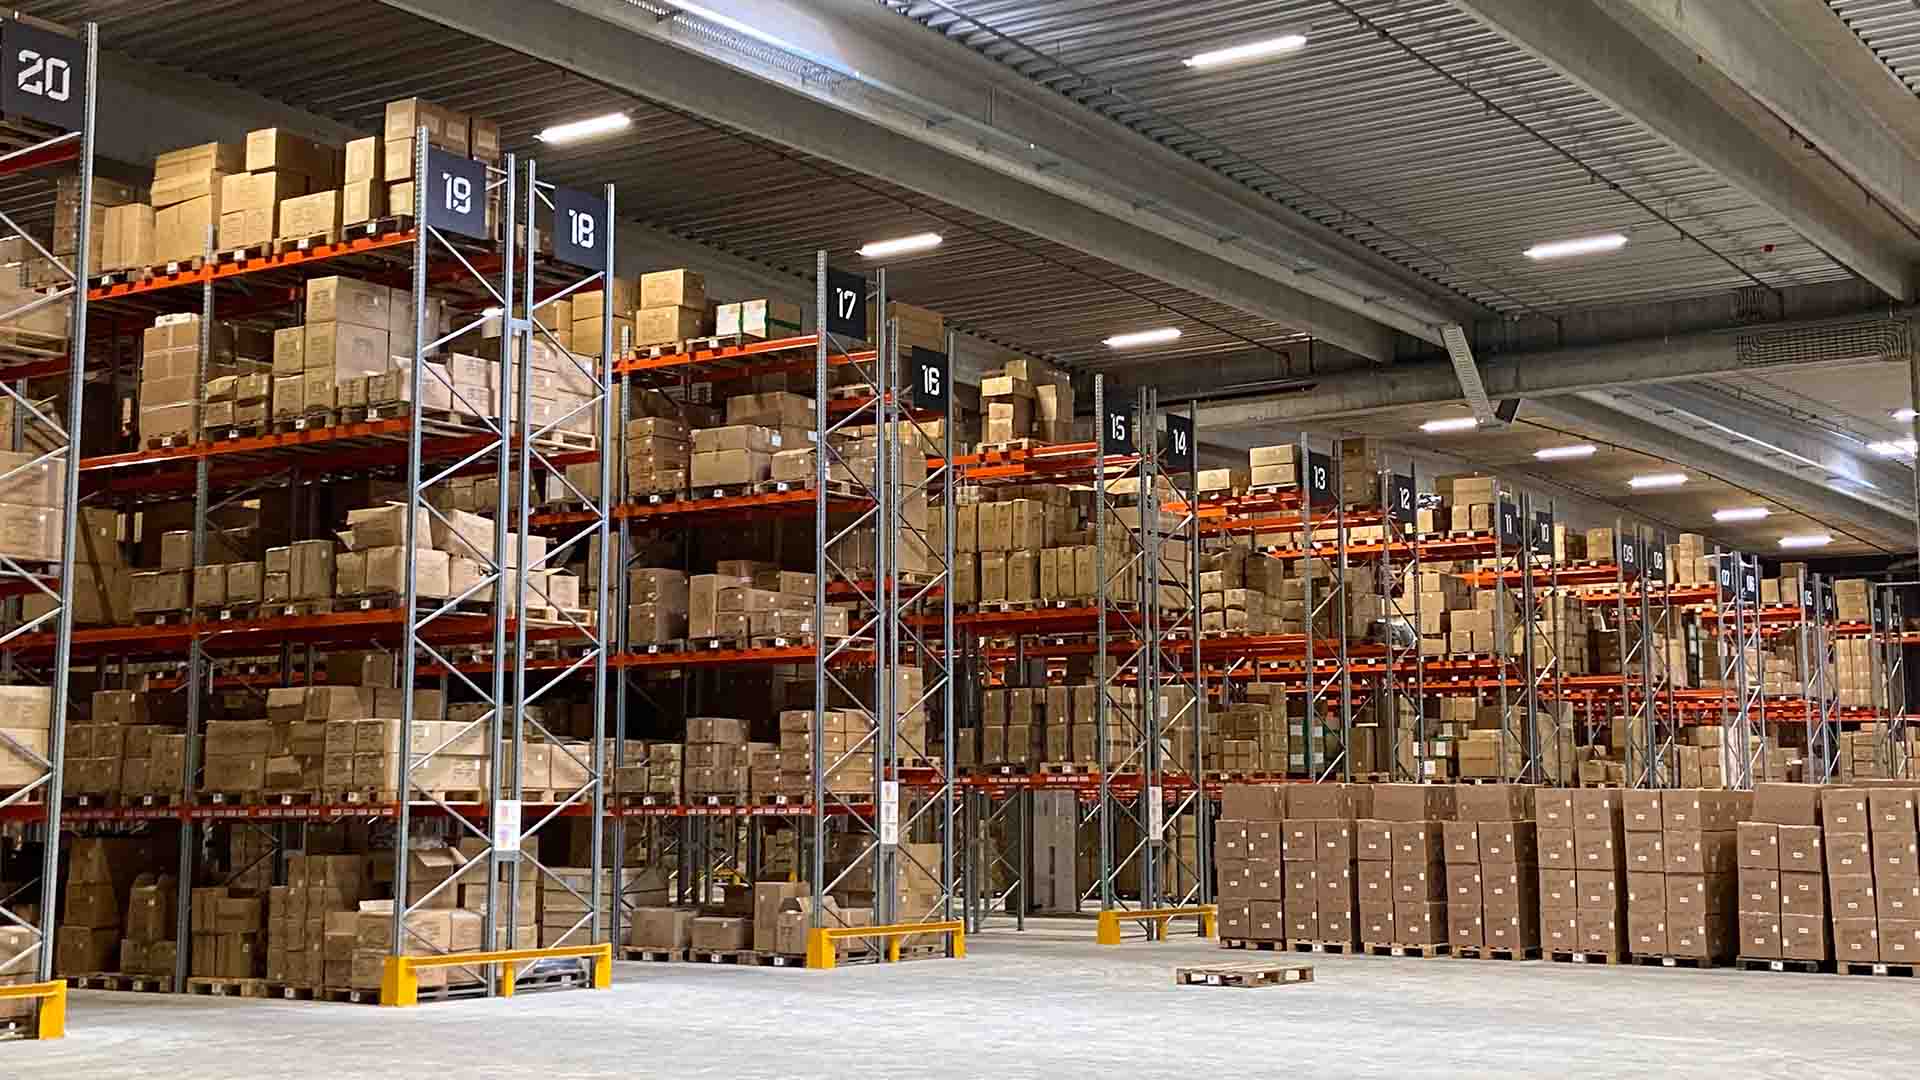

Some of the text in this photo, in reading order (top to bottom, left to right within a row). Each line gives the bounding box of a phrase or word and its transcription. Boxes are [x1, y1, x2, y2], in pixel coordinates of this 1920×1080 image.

[18, 49, 70, 101] 20
[442, 172, 471, 214] 19
[568, 209, 594, 248] 18
[836, 288, 856, 319] 17
[921, 365, 939, 395] 16
[1110, 413, 1125, 441] 15
[1173, 428, 1187, 455] 14
[1313, 466, 1325, 490] 13
[1399, 488, 1410, 510] 12
[1504, 514, 1513, 534] 11
[1540, 522, 1549, 543] 10
[1623, 544, 1634, 563] 09
[1653, 551, 1663, 570] 08
[1721, 569, 1730, 586] 07
[1804, 590, 1812, 606] 05
